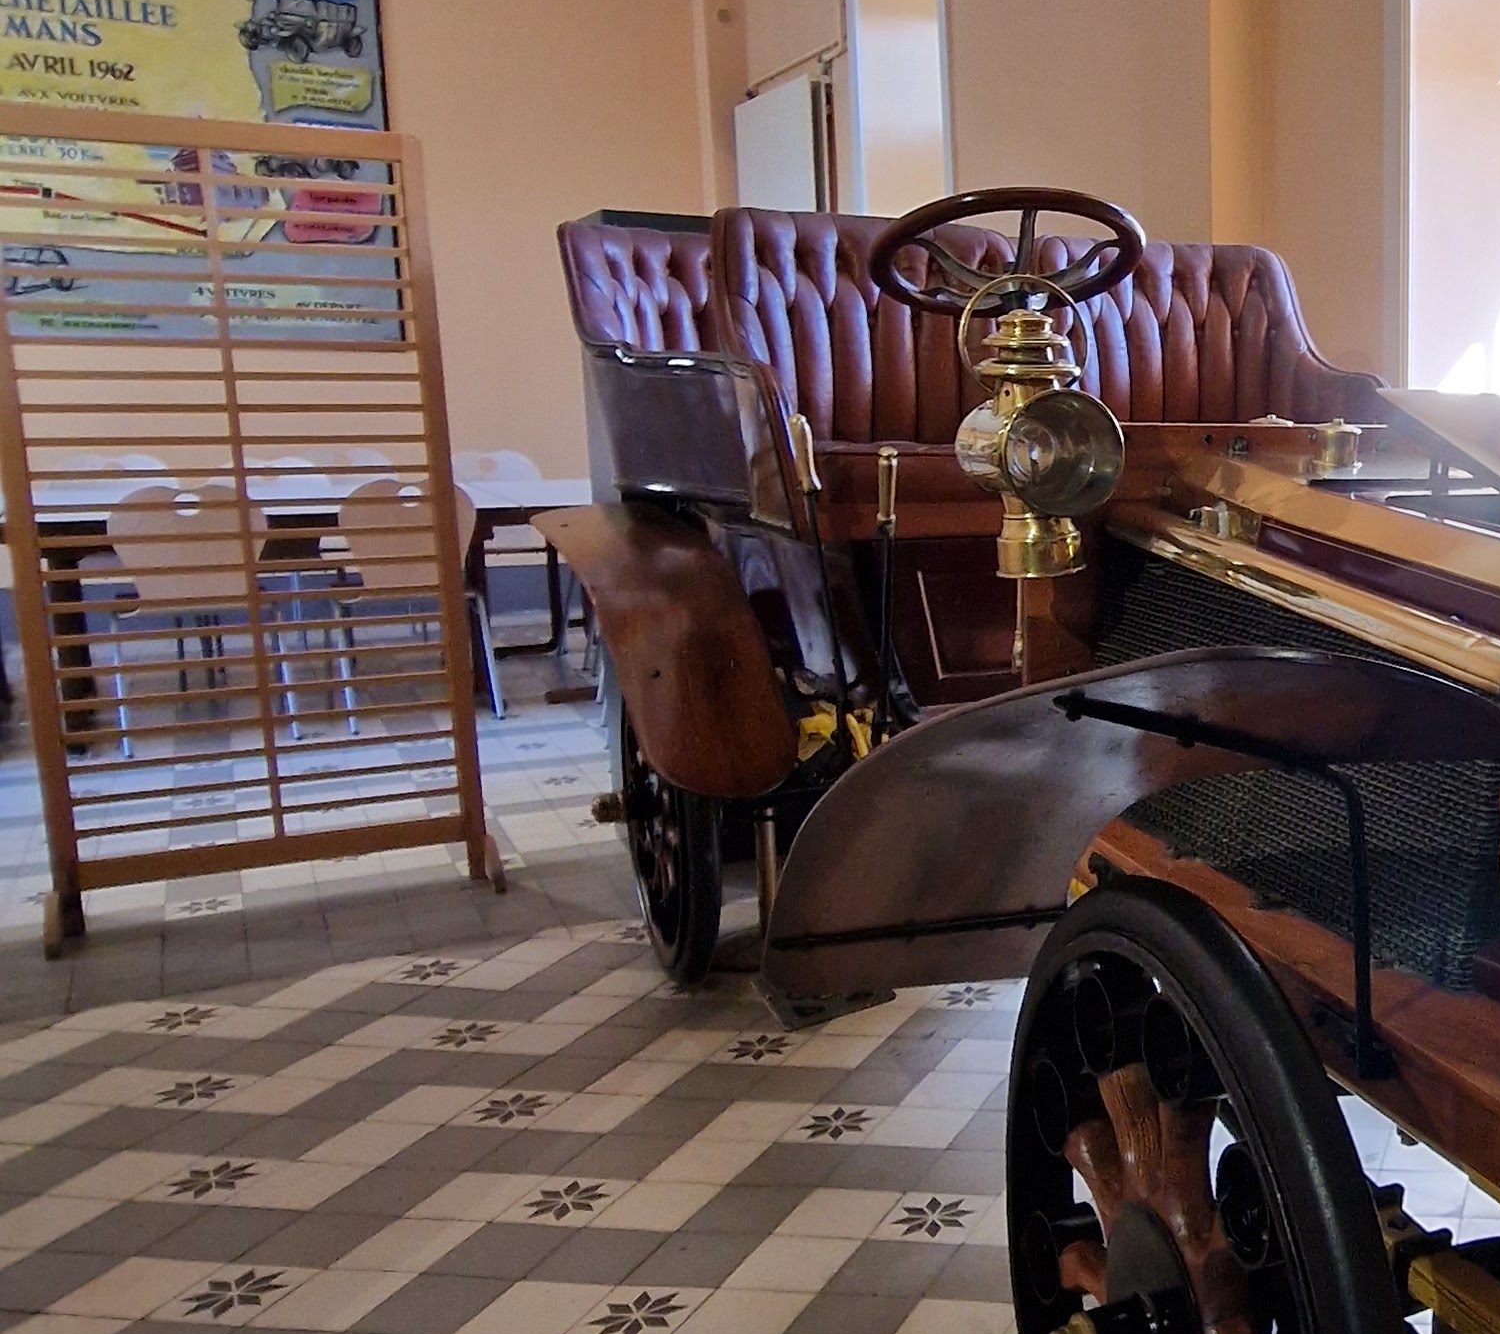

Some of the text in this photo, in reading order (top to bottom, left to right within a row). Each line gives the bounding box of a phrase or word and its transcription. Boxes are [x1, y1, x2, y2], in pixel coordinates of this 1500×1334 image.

[3, 14, 103, 47] MANS
[7, 51, 136, 82] AVRIL 1962
